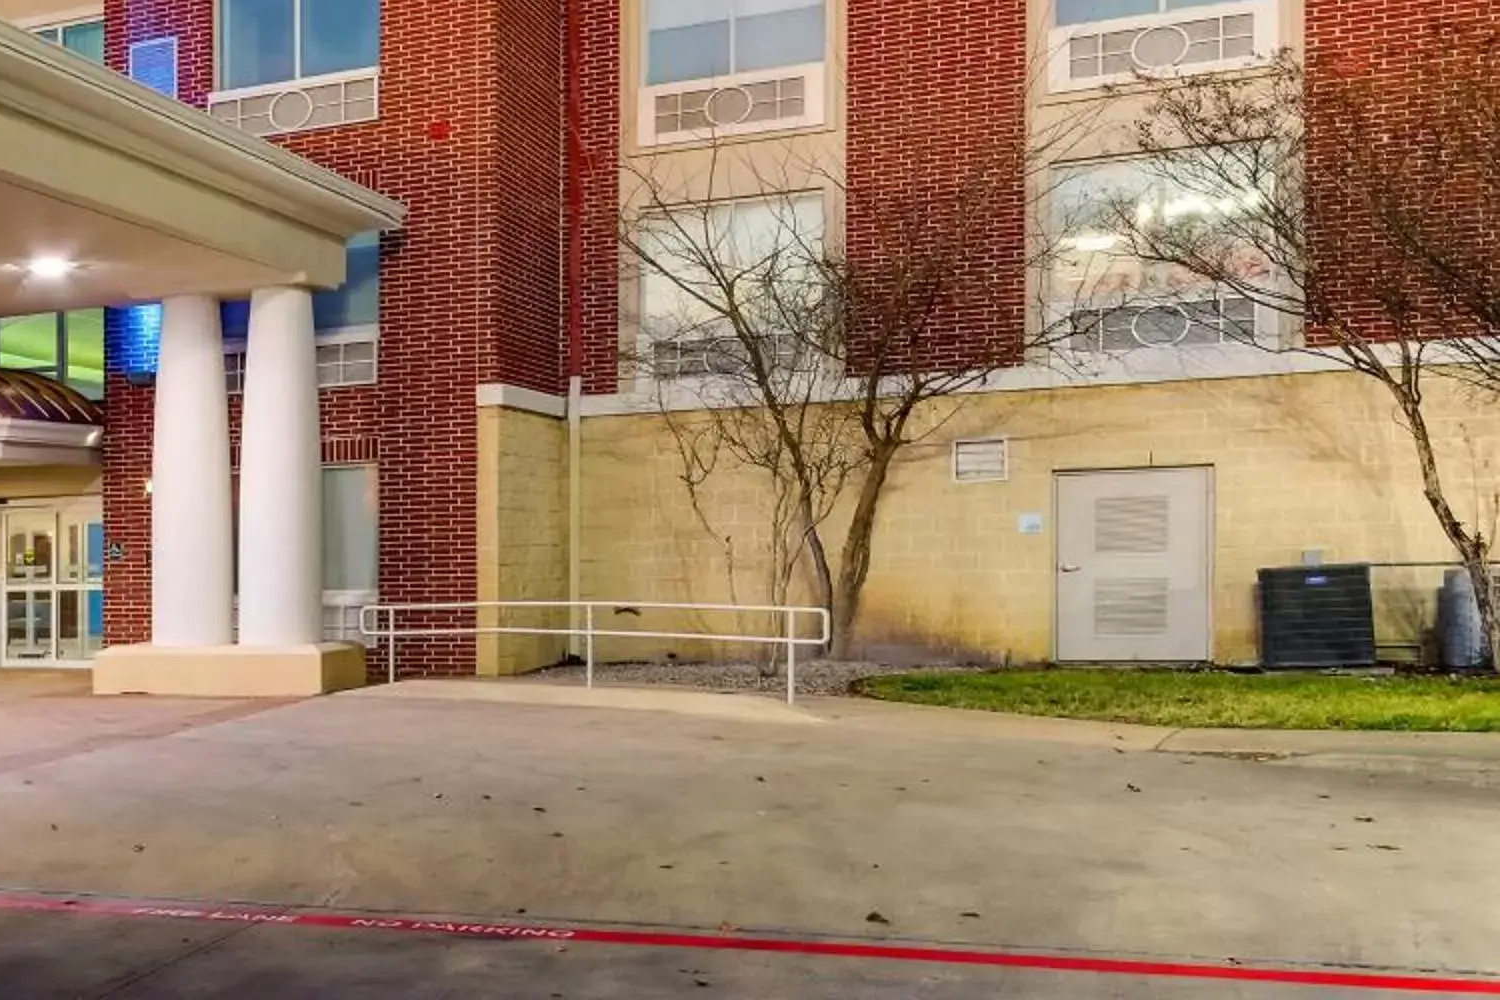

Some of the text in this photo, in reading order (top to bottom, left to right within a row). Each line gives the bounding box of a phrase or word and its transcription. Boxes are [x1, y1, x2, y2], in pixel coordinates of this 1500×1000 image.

[207, 910, 299, 923] LANE
[350, 918, 404, 928] NO
[410, 920, 577, 939] PARKING
